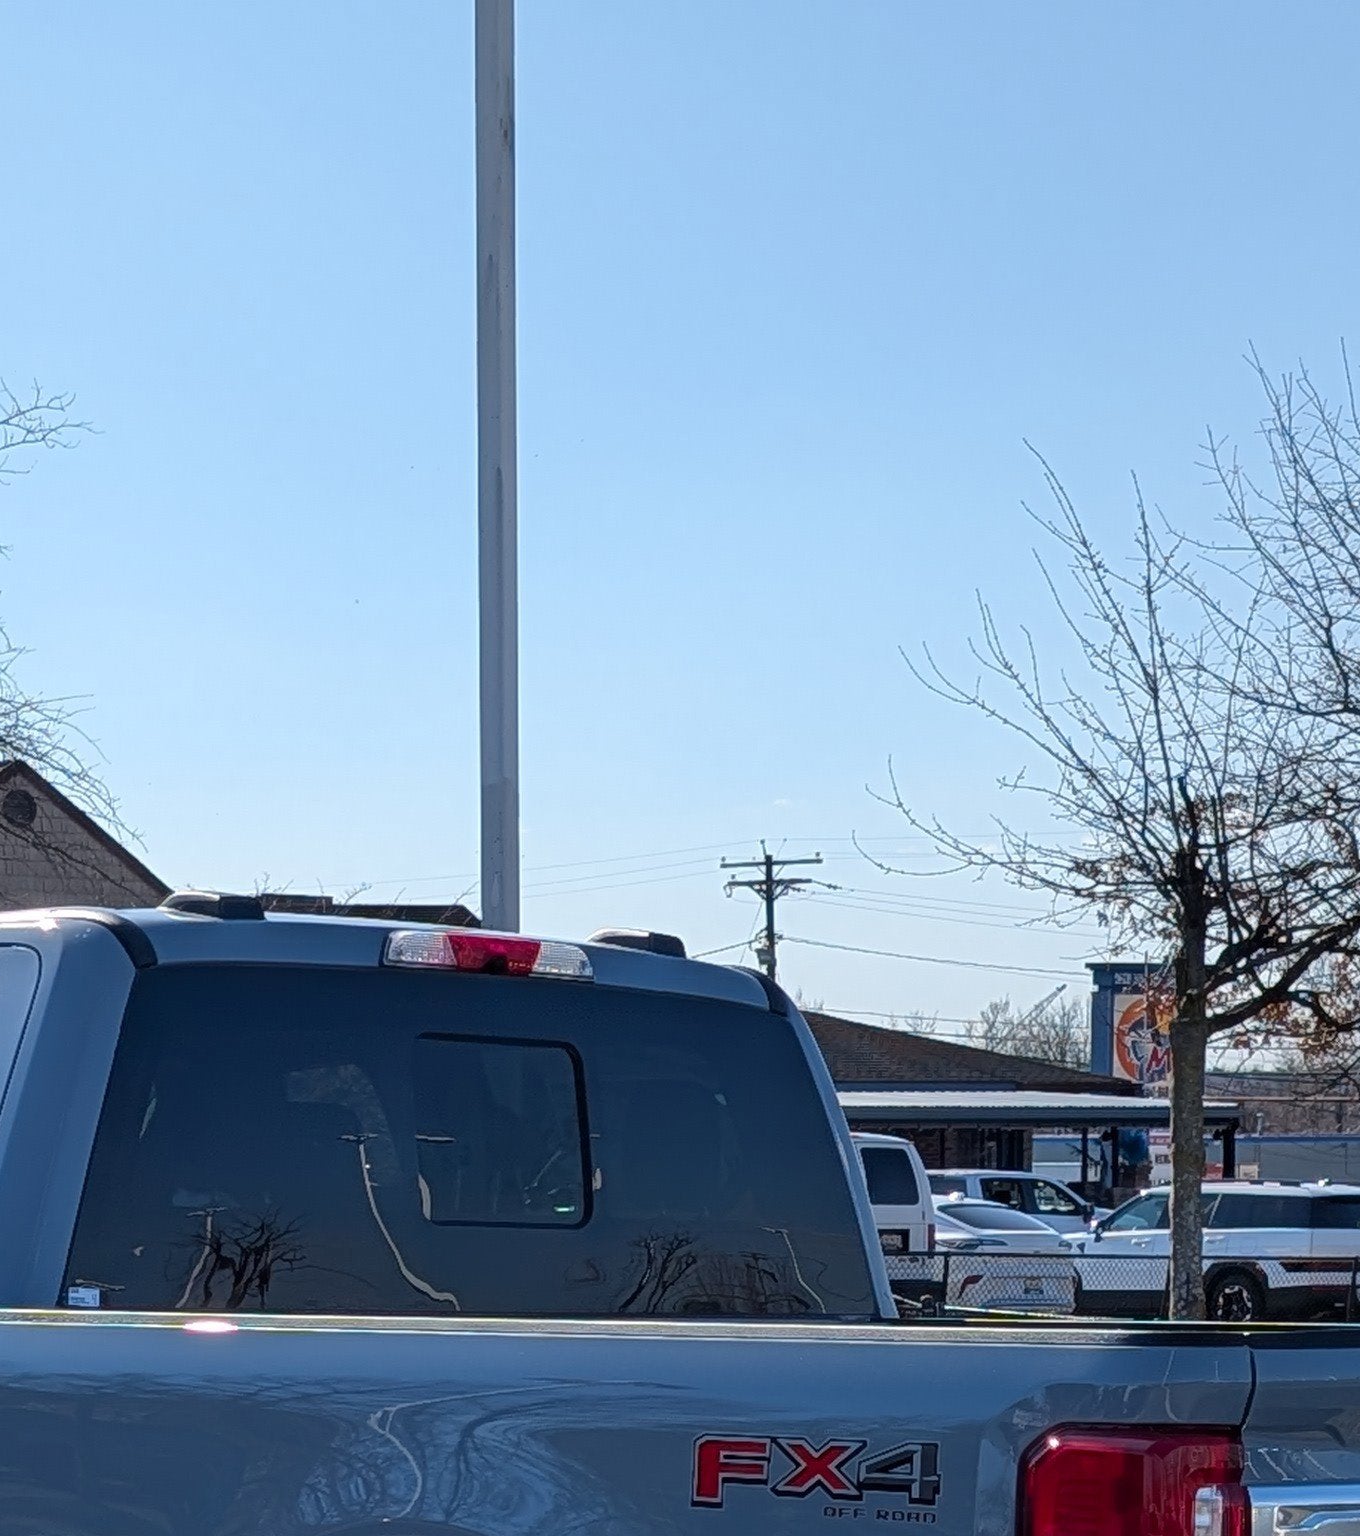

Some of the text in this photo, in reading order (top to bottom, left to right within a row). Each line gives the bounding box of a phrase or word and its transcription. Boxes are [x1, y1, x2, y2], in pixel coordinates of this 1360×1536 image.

[691, 1433, 941, 1508] FX4
[823, 1506, 937, 1523] OFF ROAD
